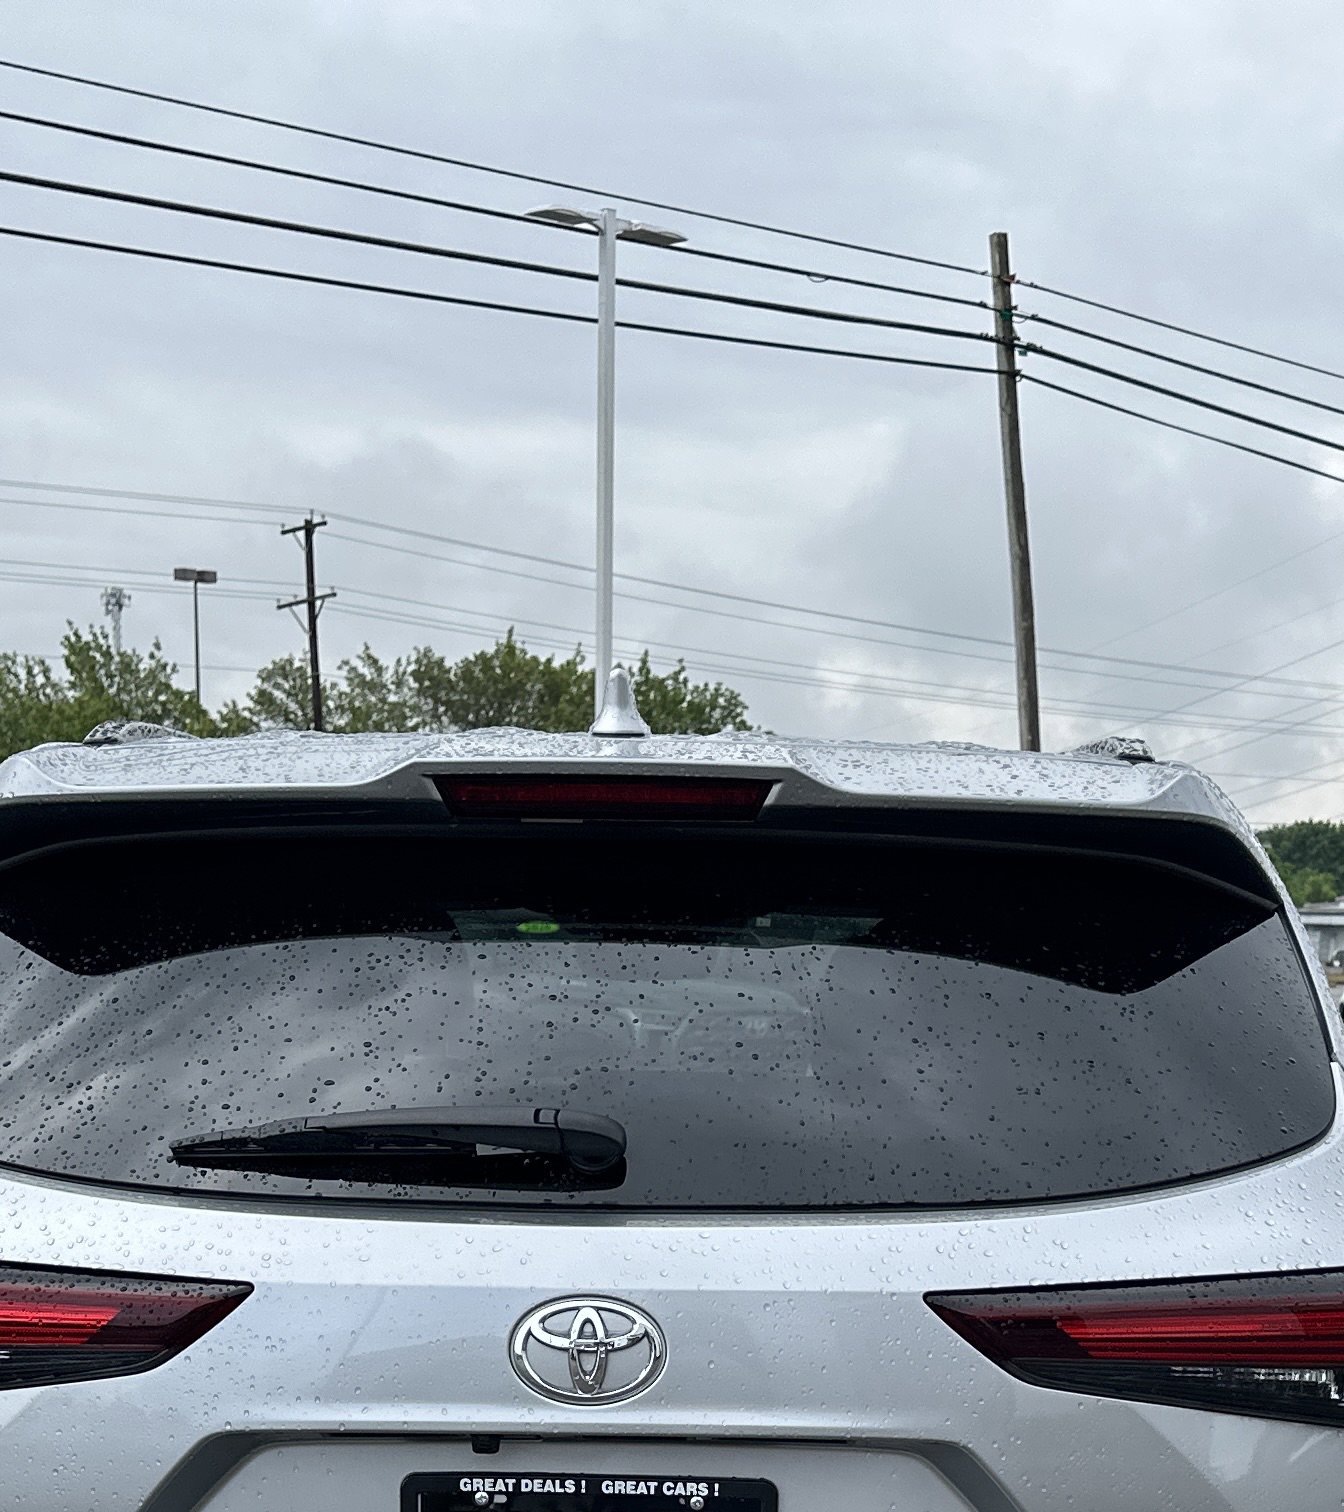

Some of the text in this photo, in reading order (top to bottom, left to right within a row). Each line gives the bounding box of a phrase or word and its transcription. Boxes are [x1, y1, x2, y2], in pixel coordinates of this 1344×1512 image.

[459, 1478, 516, 1493] GREAT
[520, 1479, 576, 1494] DEALS
[601, 1481, 658, 1496] GREAT
[662, 1482, 709, 1497] CARS
